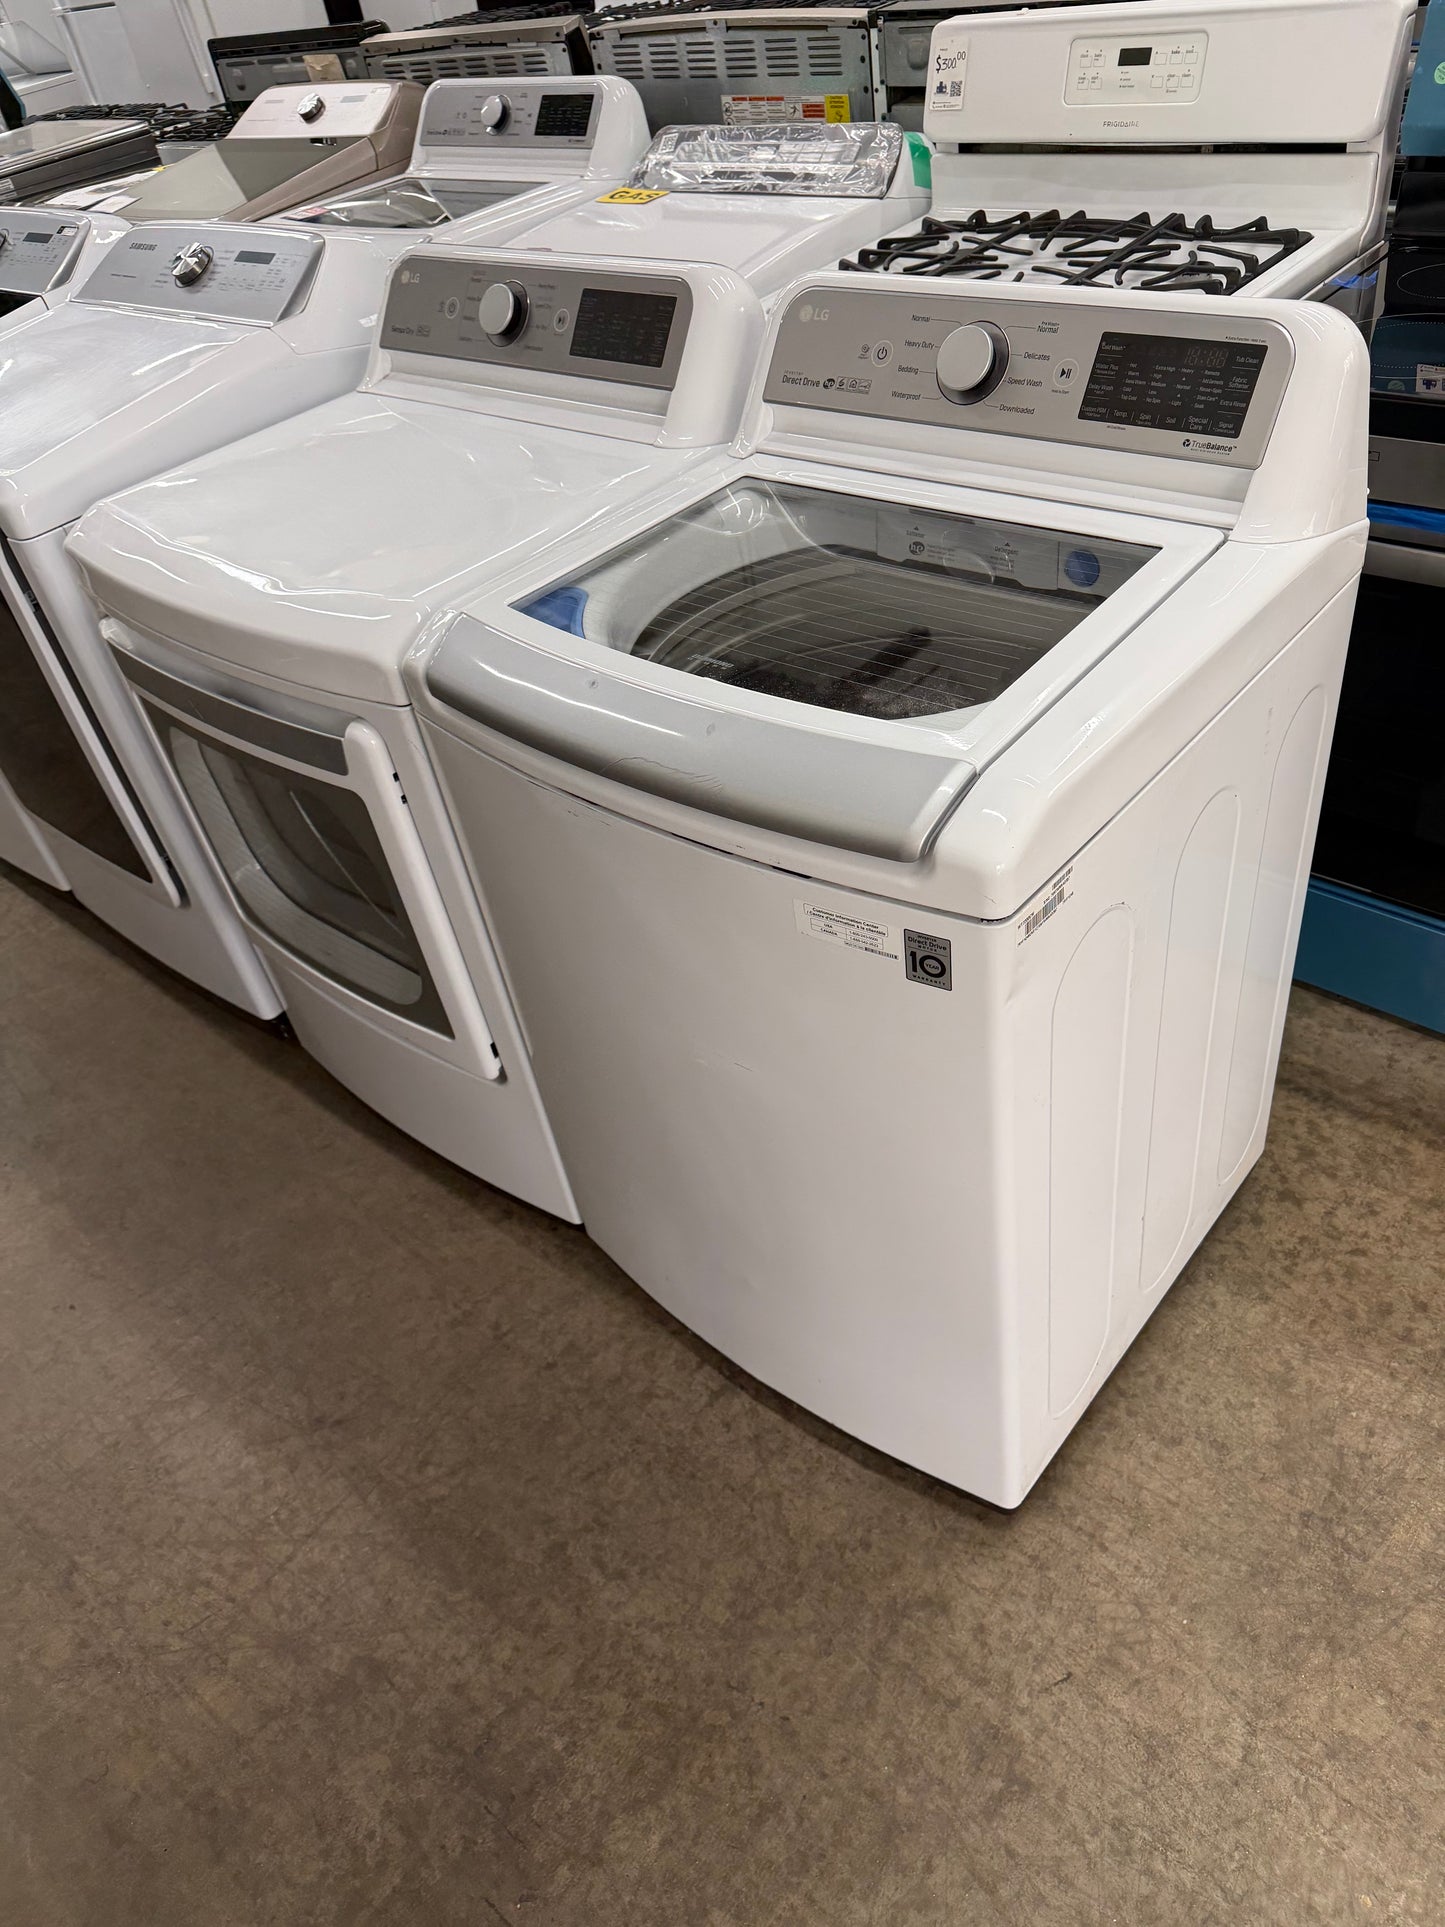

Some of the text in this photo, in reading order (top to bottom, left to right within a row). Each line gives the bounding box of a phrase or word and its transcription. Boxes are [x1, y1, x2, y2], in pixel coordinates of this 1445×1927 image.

[609, 190, 660, 201] GAS
[129, 242, 157, 251] SAMSUNG
[410, 273, 420, 284] LG
[814, 309, 830, 320] LG
[911, 314, 931, 323] Normal
[1036, 325, 1059, 334] Normal
[904, 340, 935, 350] Heavy Duty
[1023, 352, 1051, 361] Delicates
[898, 365, 919, 375] Bedding
[782, 375, 821, 388] Direct Drive
[1007, 377, 1043, 387] Speed Wash
[1232, 376, 1248, 384] Fabric
[891, 391, 921, 401] Waterproof
[1219, 399, 1232, 407] Extra
[999, 404, 1036, 415] Downloaded
[1139, 413, 1151, 421] Spin
[1165, 416, 1177, 424] Soil
[1188, 416, 1209, 425] Special
[1218, 421, 1234, 430] Signal
[809, 911, 825, 920] Centre
[812, 907, 879, 930] Customer Information Center
[907, 936, 947, 950] Direct Drive
[909, 950, 946, 978] 10
[924, 962, 940, 971] YEAR
[912, 974, 946, 986] WARRANTY
